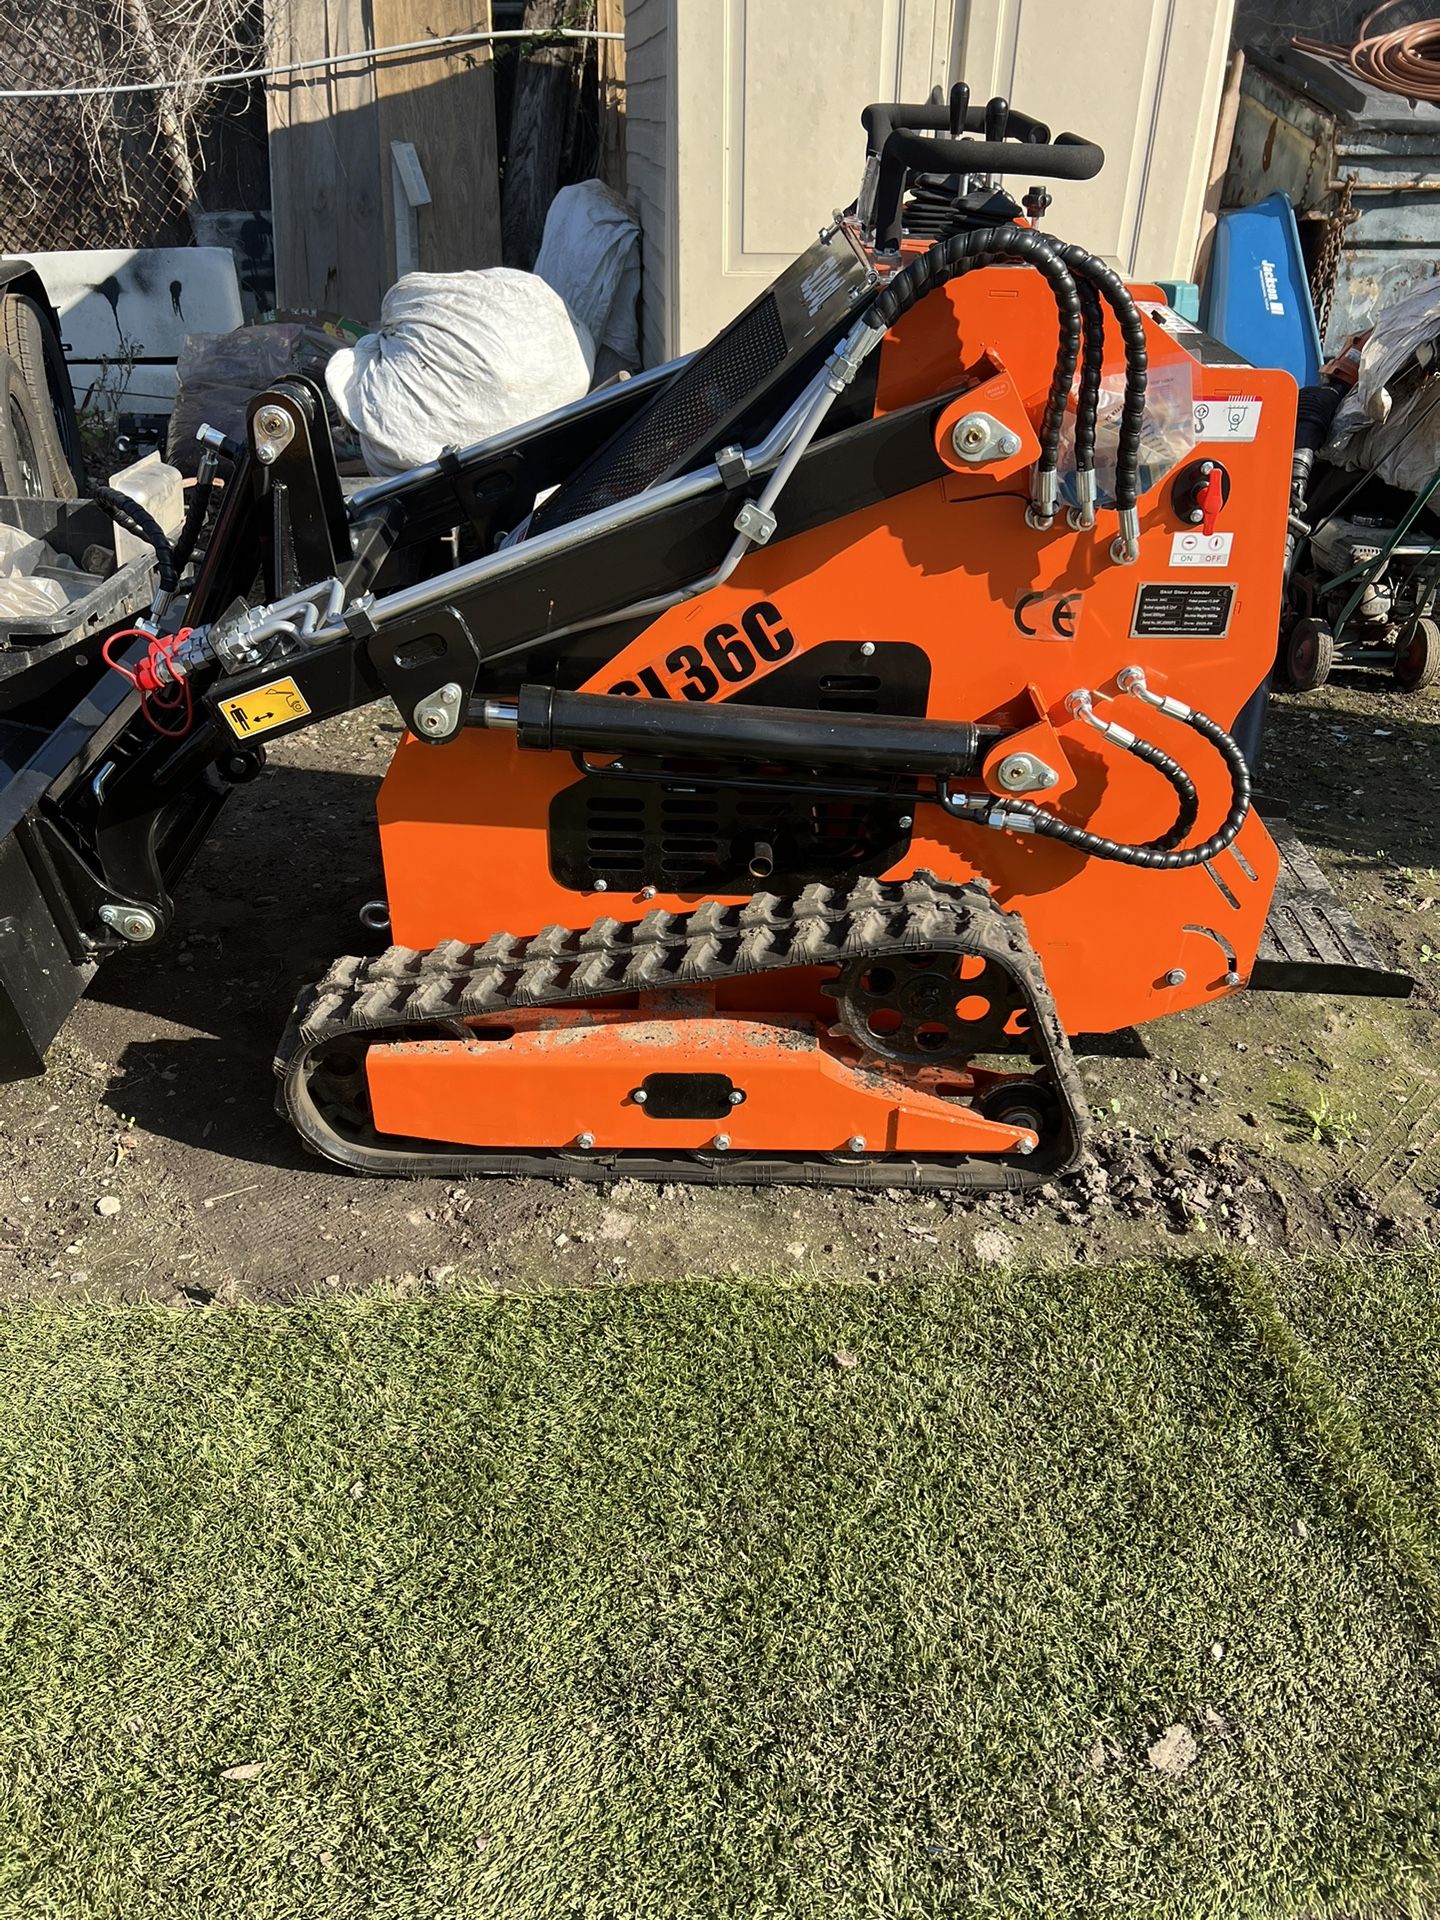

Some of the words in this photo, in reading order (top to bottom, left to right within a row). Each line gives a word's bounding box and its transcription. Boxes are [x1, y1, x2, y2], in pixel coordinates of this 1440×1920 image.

[1261, 259, 1279, 301] Jackson
[1180, 554, 1193, 562] ON
[1204, 554, 1222, 562] OFF
[1013, 590, 1083, 638] CE
